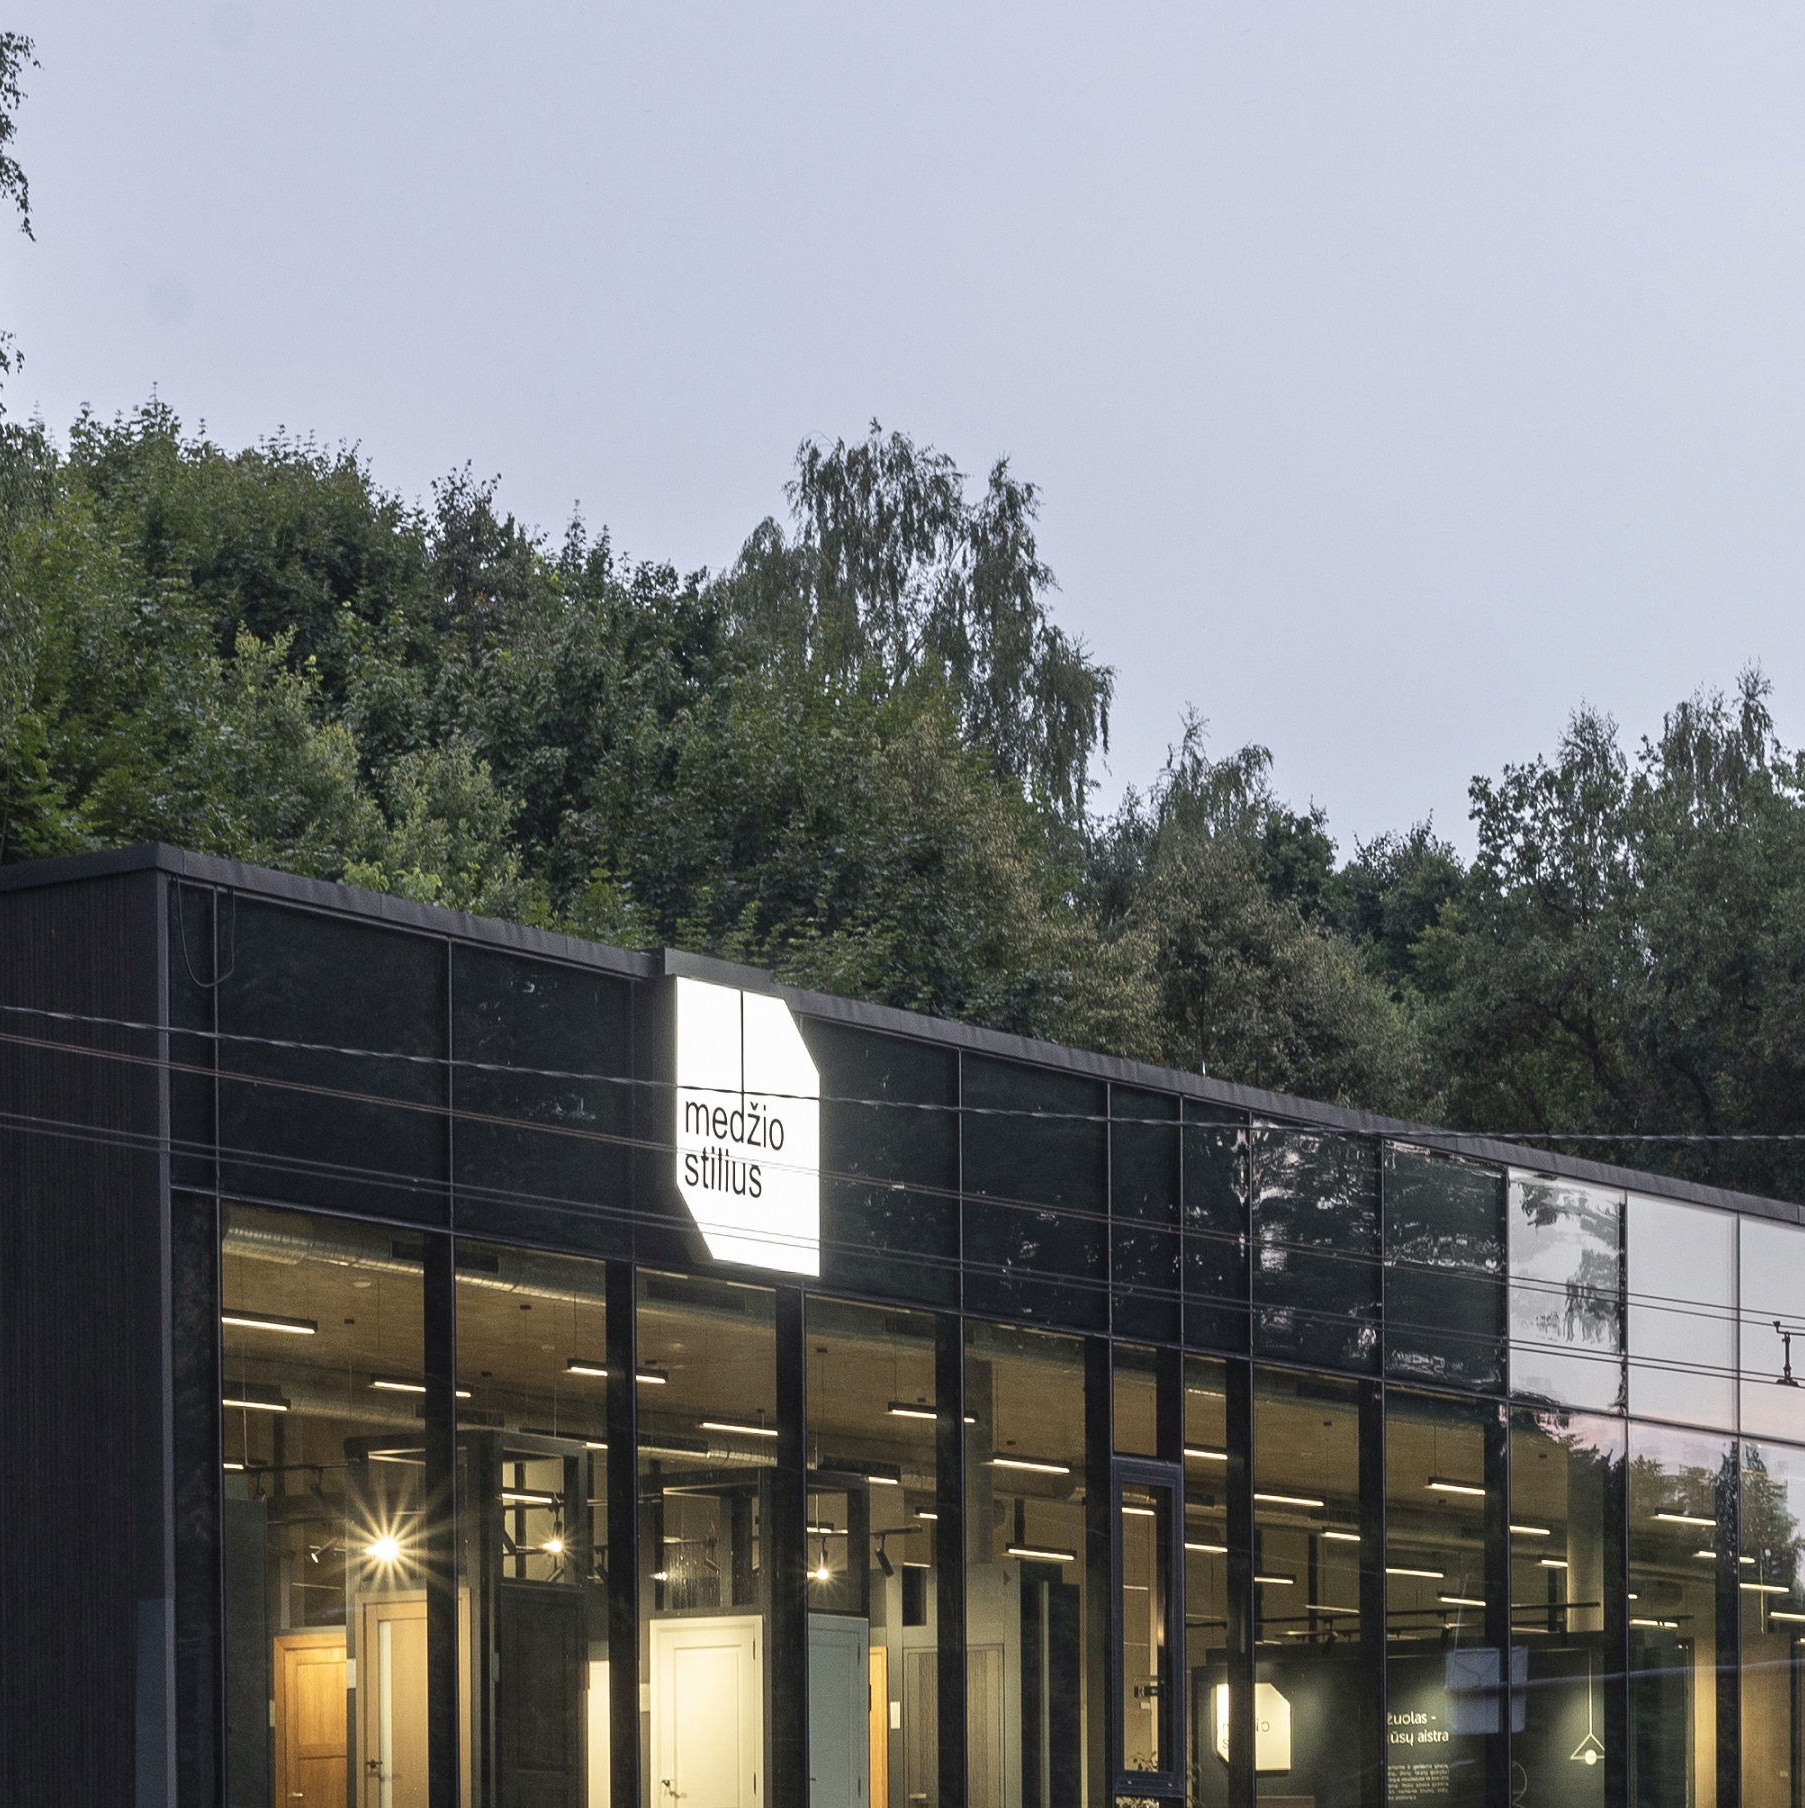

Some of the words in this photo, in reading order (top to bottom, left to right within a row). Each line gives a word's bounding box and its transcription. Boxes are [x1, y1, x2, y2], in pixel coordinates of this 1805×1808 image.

[685, 1100, 785, 1151] medžio
[684, 1146, 762, 1198] stilius
[1387, 1710, 1428, 1726] žuolas
[1387, 1730, 1414, 1747] ūsų
[1417, 1728, 1450, 1743] aistra
